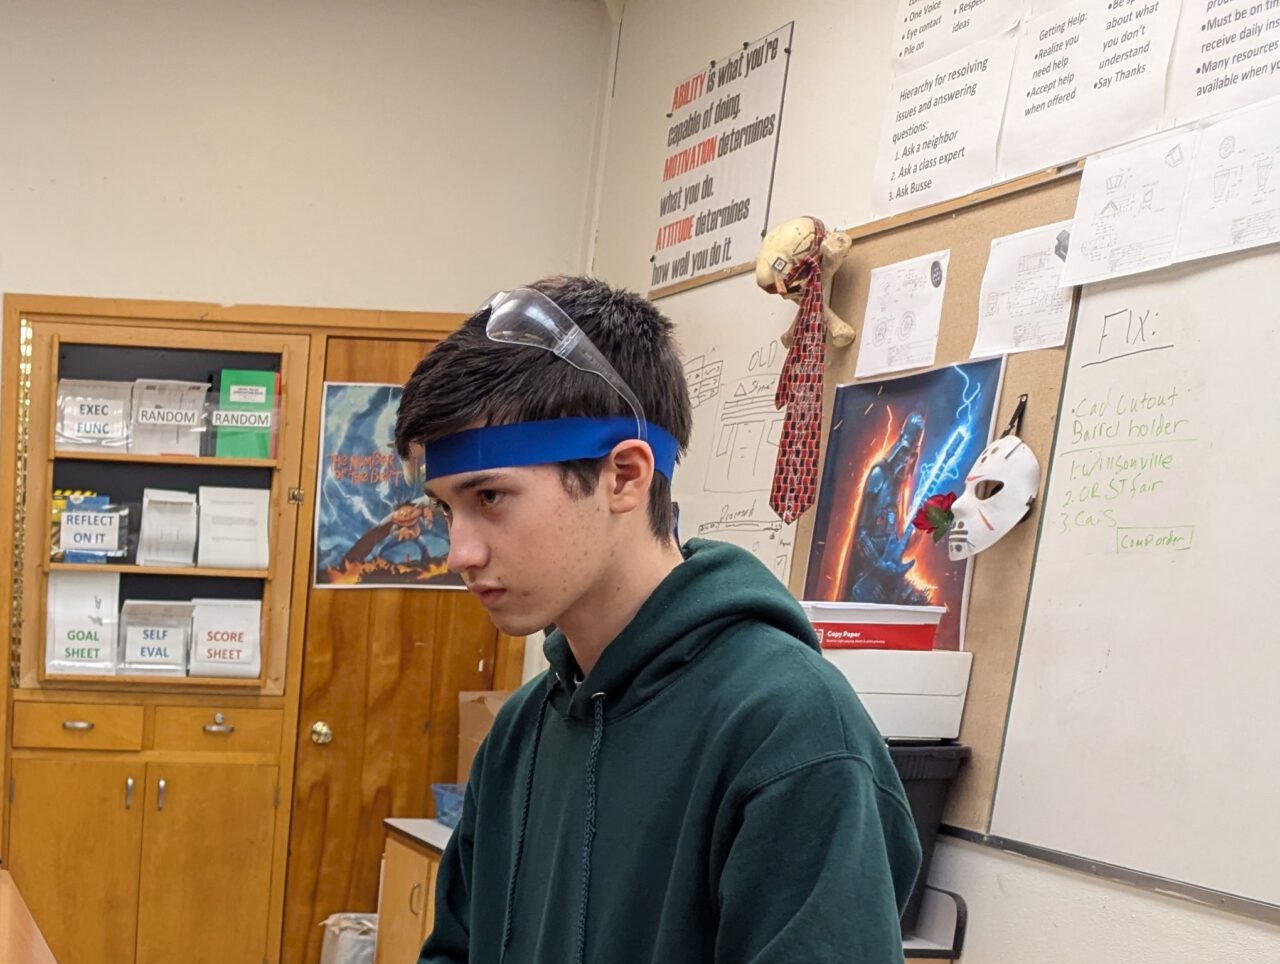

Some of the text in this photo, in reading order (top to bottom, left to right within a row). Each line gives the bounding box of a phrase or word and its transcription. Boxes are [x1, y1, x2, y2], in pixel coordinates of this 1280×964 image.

[918, 16, 942, 35] contact
[952, 19, 970, 33] ideas
[1039, 12, 1088, 41] Getting Help:
[1105, 3, 1160, 31] about what
[1206, 4, 1263, 32] Must be on
[1037, 33, 1080, 60] Realize you
[1102, 24, 1146, 52] you don't
[1201, 33, 1237, 53] receive
[1239, 23, 1263, 41] daily
[1032, 56, 1069, 80] need help
[1098, 41, 1151, 70] understand
[1201, 39, 1280, 75] Many resources
[672, 38, 779, 111] ABILITY is what you're
[899, 57, 988, 102] Hierarchy for resolving
[1030, 72, 1075, 99] Accept help
[1097, 64, 1147, 90] Say Thanks
[1196, 65, 1268, 97] available when
[895, 82, 978, 123] issues and answering
[1024, 88, 1077, 117] when offered
[667, 92, 741, 147] capable of doing.
[892, 120, 928, 143] questions:
[662, 113, 776, 183] MOTIVATION determines
[901, 143, 915, 158] Ask
[921, 129, 959, 150] neighbor
[898, 165, 911, 180] Ask
[918, 156, 937, 171] class
[938, 147, 966, 166] expert
[659, 174, 714, 217] what you do.
[895, 183, 909, 198] Ask
[910, 178, 933, 194] Busse
[655, 198, 751, 252] ATTITUDE determines
[651, 236, 732, 286] how well you do it.
[79, 404, 109, 416] EXEC
[141, 410, 196, 424] RANDOM
[214, 413, 270, 426] RANDOM
[77, 422, 110, 434] FUNC
[66, 515, 114, 527] REFLECT
[73, 533, 106, 544] ON IT
[67, 630, 100, 642] GOAL
[143, 629, 168, 641] SELF
[206, 631, 244, 643] SCORE
[827, 630, 861, 639] Copy Paper
[65, 648, 100, 659] SHEET
[140, 646, 169, 658] EVAL
[206, 648, 242, 660] SHEET
